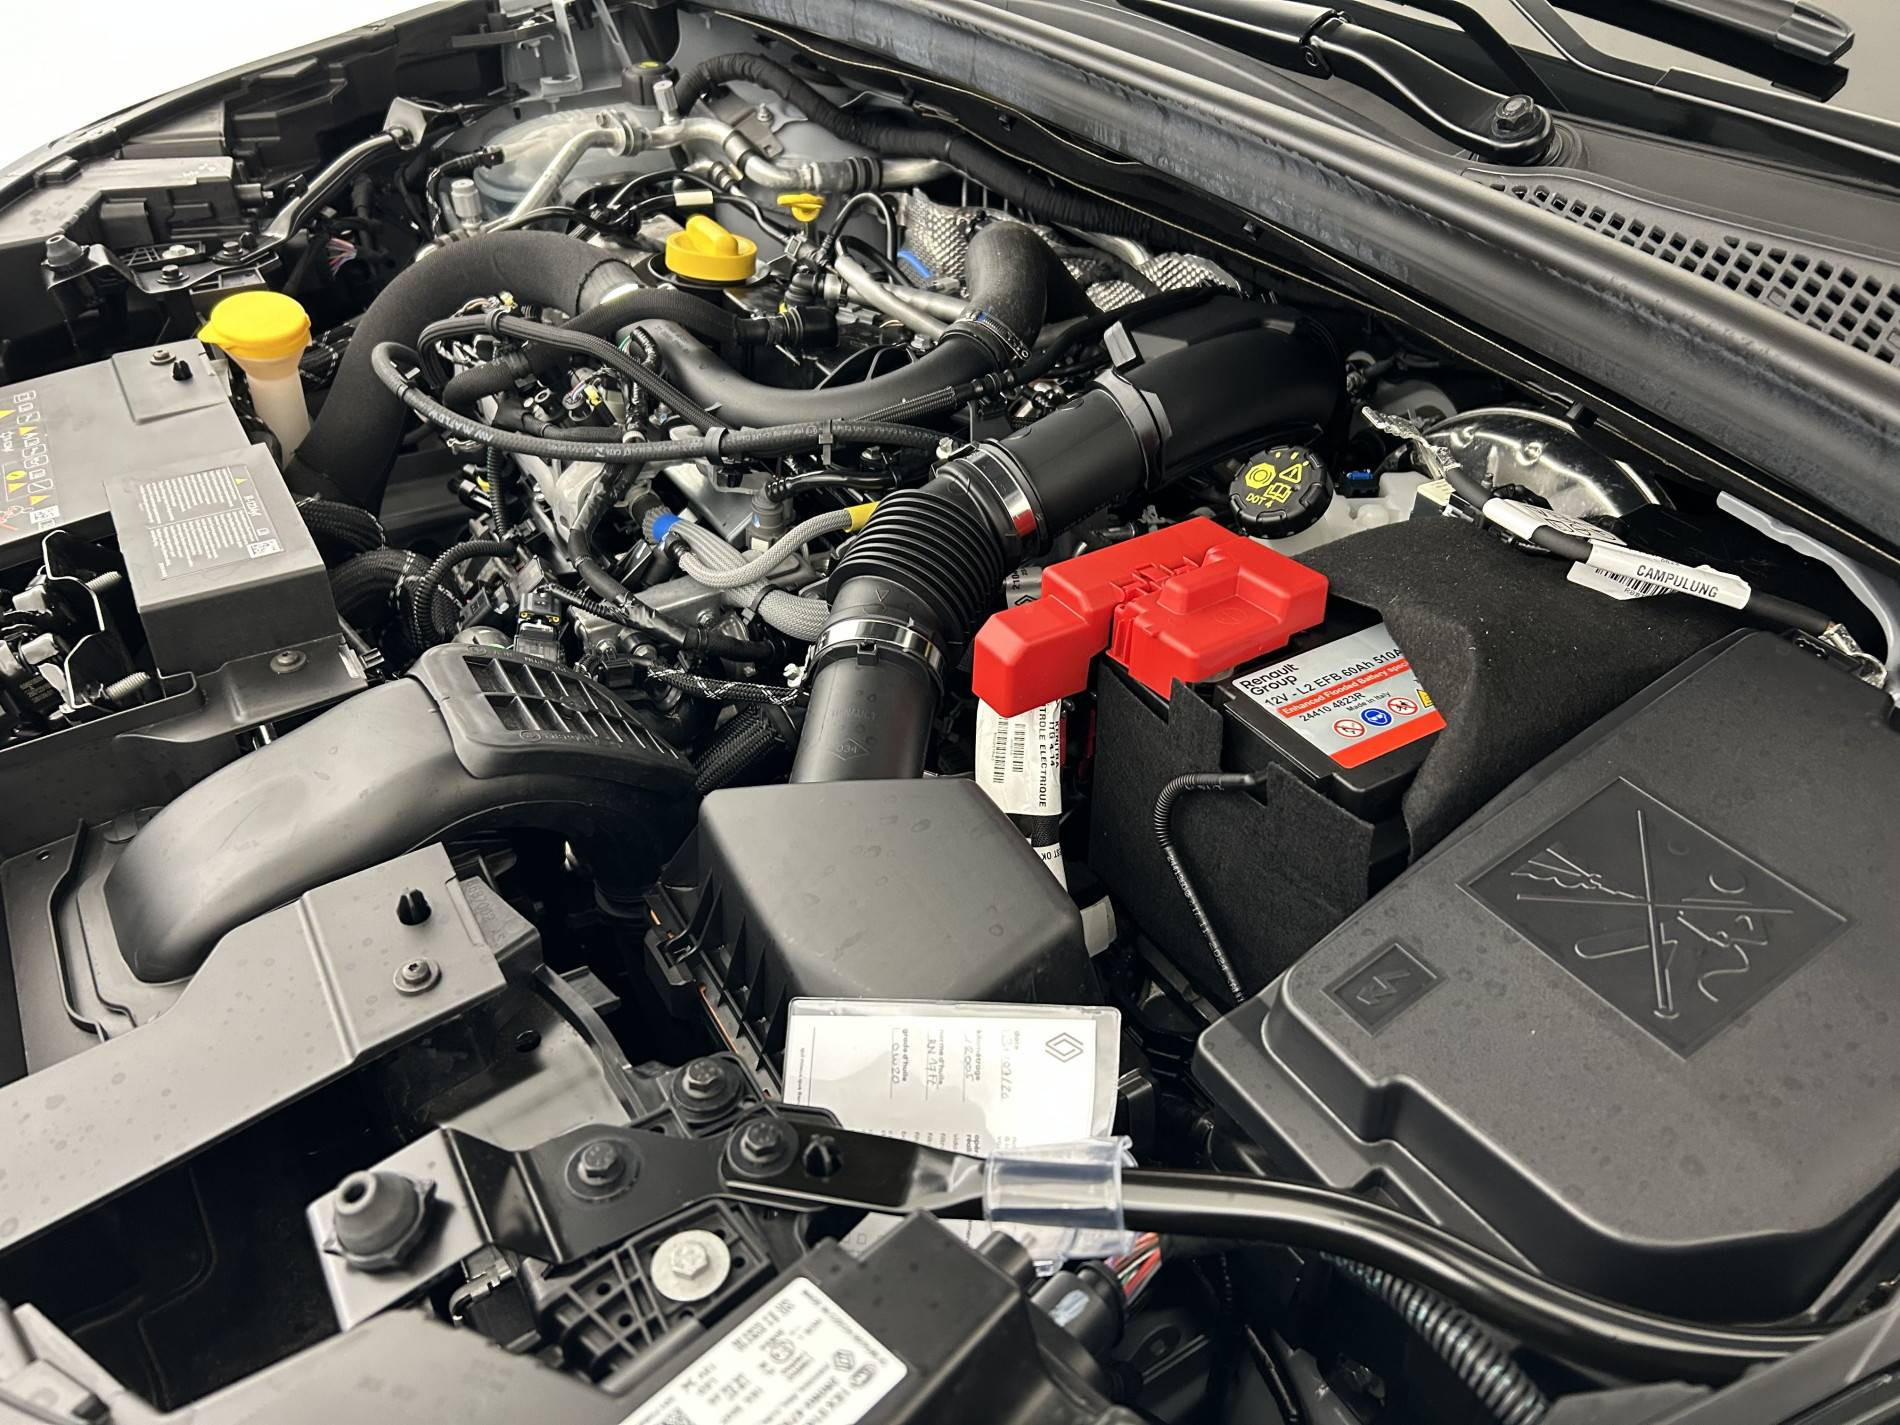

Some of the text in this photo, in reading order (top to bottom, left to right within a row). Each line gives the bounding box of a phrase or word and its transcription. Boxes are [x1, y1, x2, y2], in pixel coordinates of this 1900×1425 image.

[1246, 493, 1266, 505] DOT
[1636, 565, 1719, 598] CAMPULUNG
[1240, 663, 1299, 689] Renault
[1250, 675, 1297, 695] Group
[1265, 693, 1289, 706] 12V
[1296, 683, 1316, 695] L2
[1314, 673, 1342, 688] EFB
[1341, 661, 1375, 677] 60Ah
[1373, 648, 1402, 664] 510A
[1282, 695, 1326, 714] Enhanced
[1324, 681, 1359, 698] Flooded
[1357, 670, 1388, 684] Battery
[1299, 692, 1365, 721] 24410 4823R
[1346, 701, 1367, 711] Made
[1375, 691, 1391, 701] Italy
[1039, 707, 1047, 808] TROLE ELECTRIQUE
